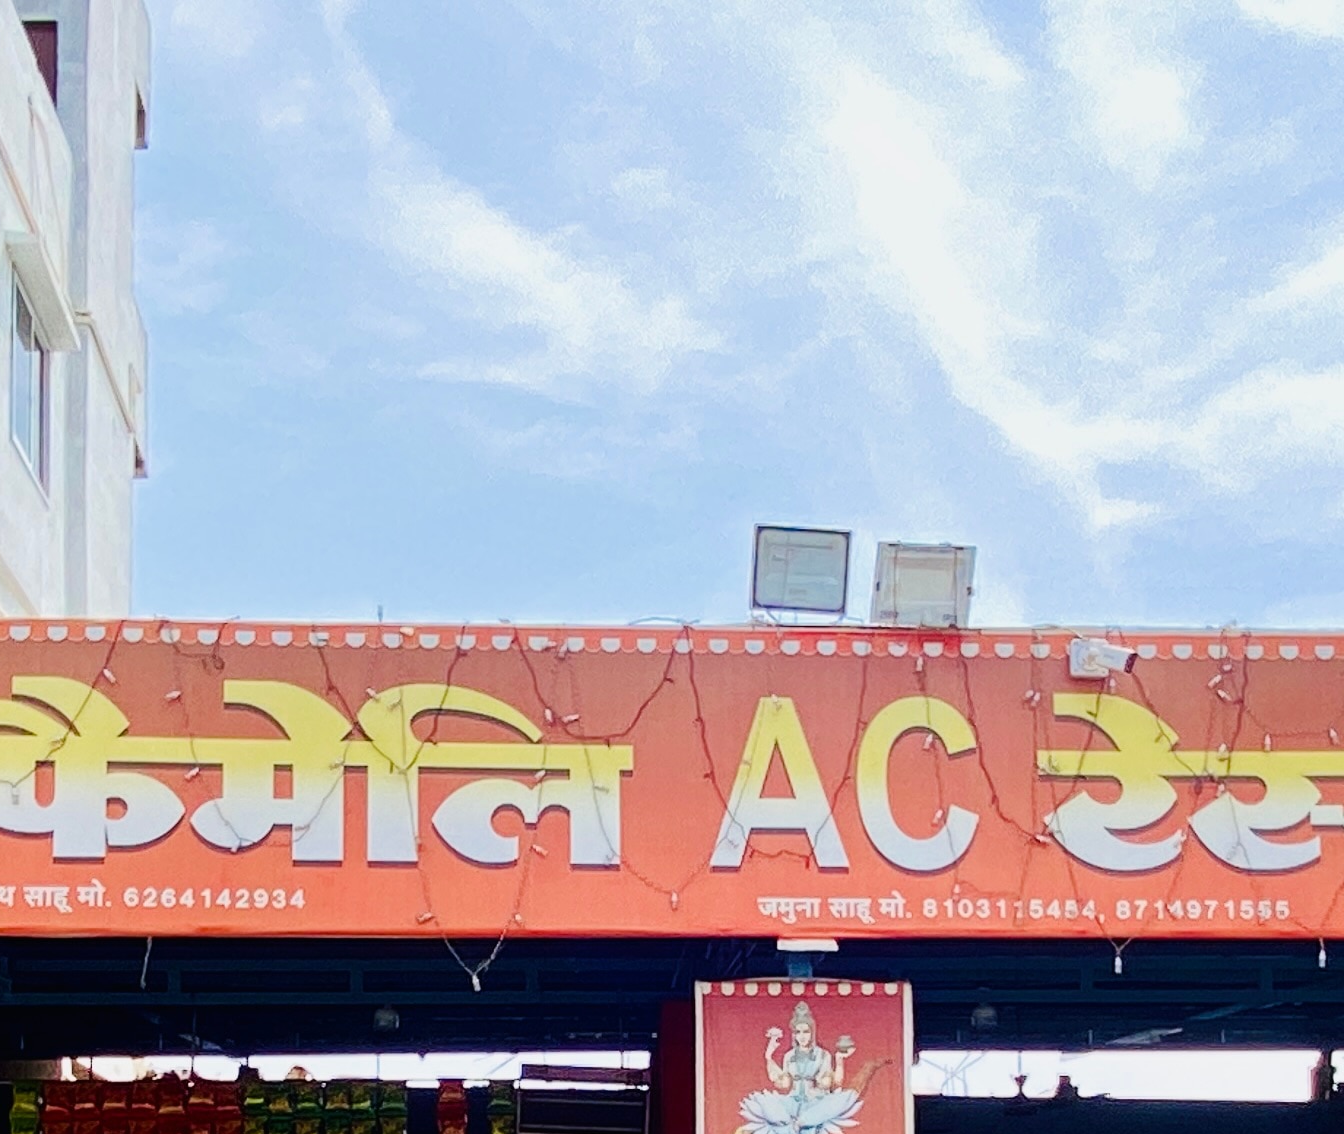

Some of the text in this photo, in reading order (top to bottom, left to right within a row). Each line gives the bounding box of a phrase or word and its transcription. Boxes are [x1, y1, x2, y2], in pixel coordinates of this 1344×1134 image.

[709, 693, 980, 874] AC
[22, 884, 73, 913] साहू
[76, 878, 112, 908] मो.
[122, 886, 307, 910] 6264142934
[756, 897, 822, 925] जमुना
[827, 897, 876, 925] साहू
[878, 889, 913, 919] मो.
